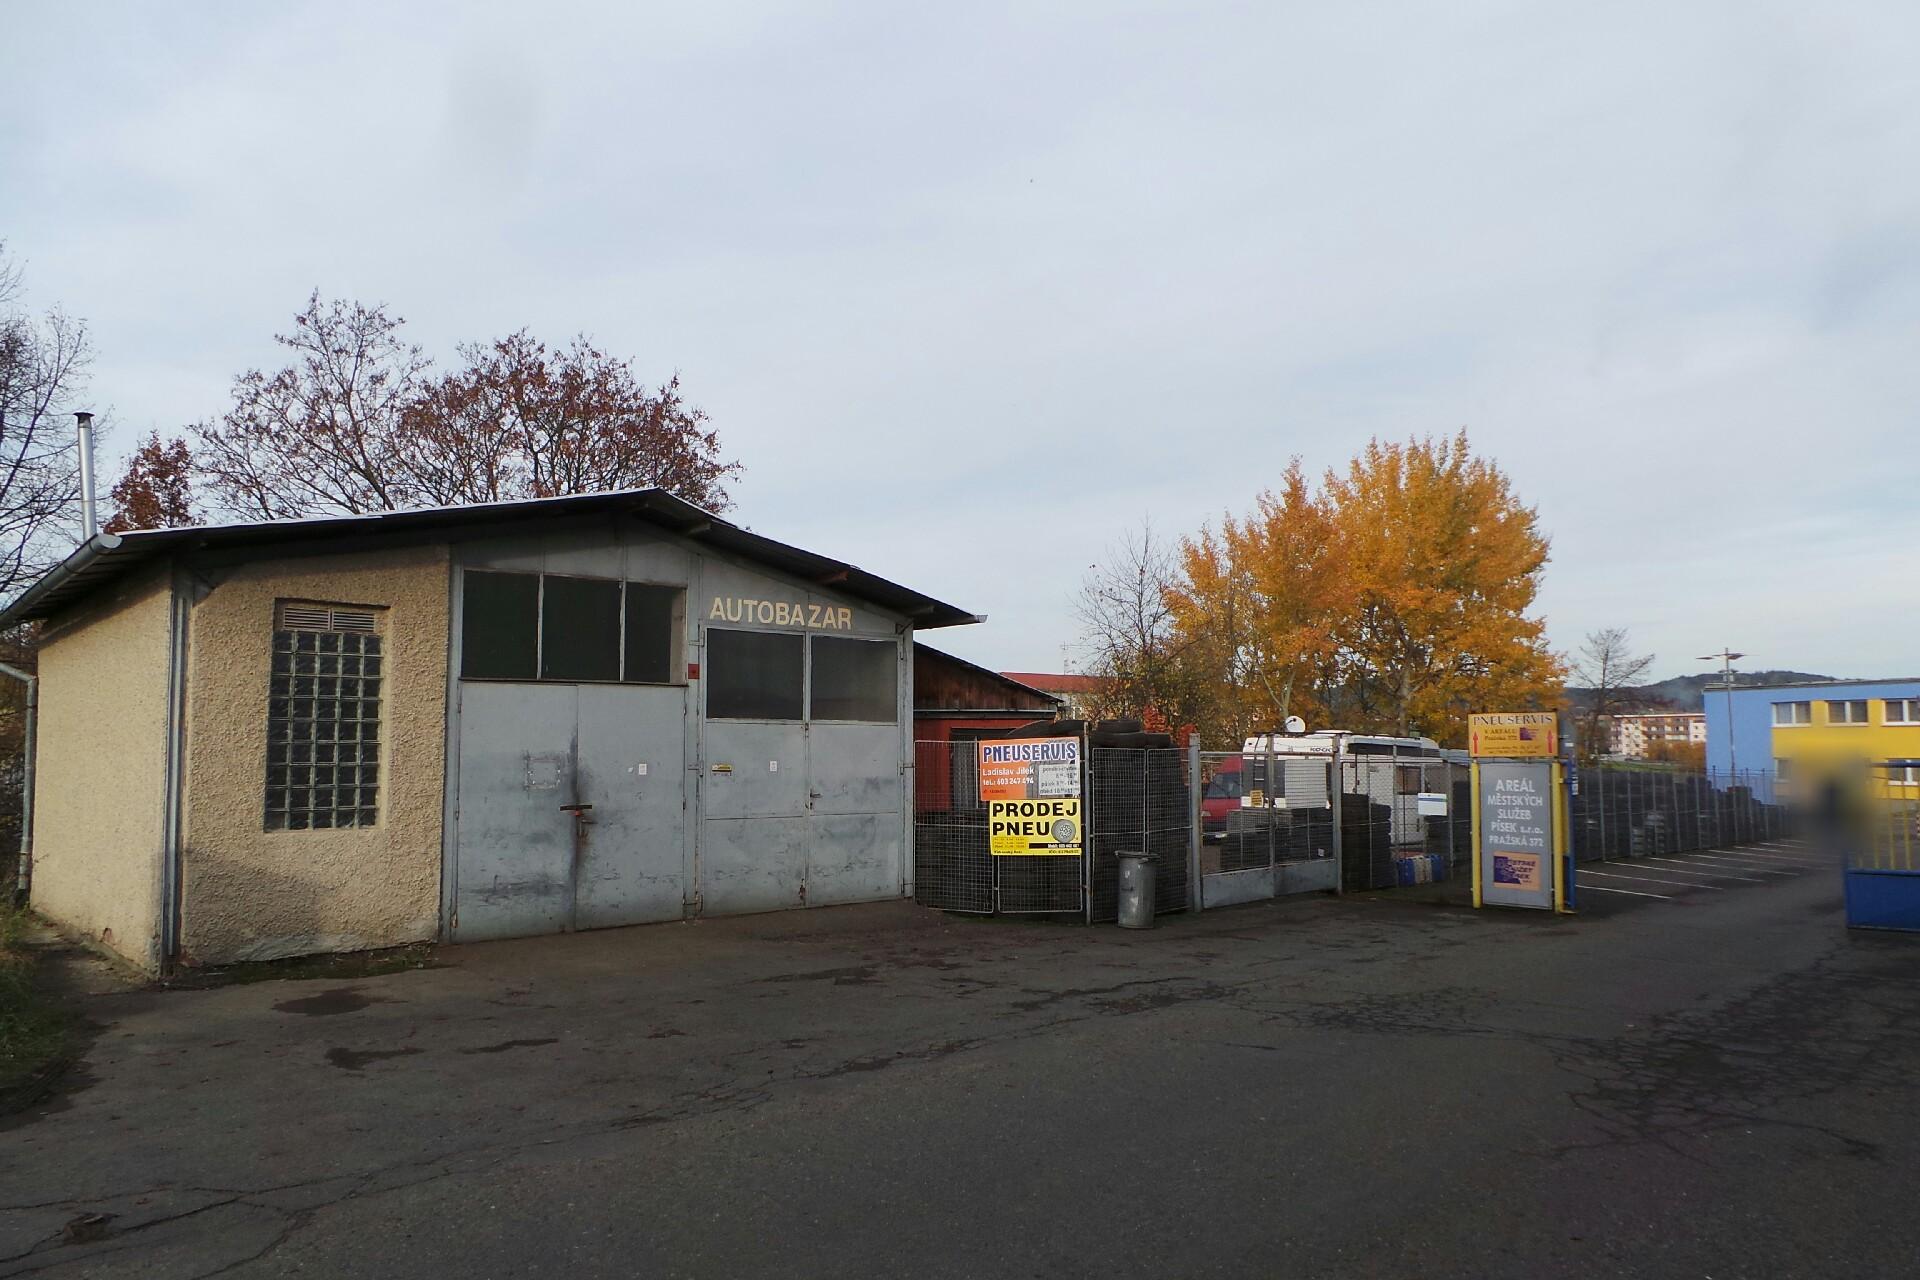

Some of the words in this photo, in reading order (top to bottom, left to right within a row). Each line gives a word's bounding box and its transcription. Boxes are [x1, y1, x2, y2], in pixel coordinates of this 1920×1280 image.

[709, 597, 852, 630] AUTOBAZAR
[983, 742, 1077, 763] PNEUSERVIS
[982, 767, 1014, 776] Ladislav
[1495, 778, 1536, 793] AREÁL
[1487, 794, 1543, 806] MĚSTSKÝCH
[992, 802, 1077, 817] PRODEJ
[1497, 807, 1532, 820] SLUŽEB
[992, 821, 1050, 836] PNEU
[1490, 820, 1517, 833] PÍSEK
[1488, 834, 1527, 847] PRAŽSKÁ
[1529, 837, 1544, 847] 372
